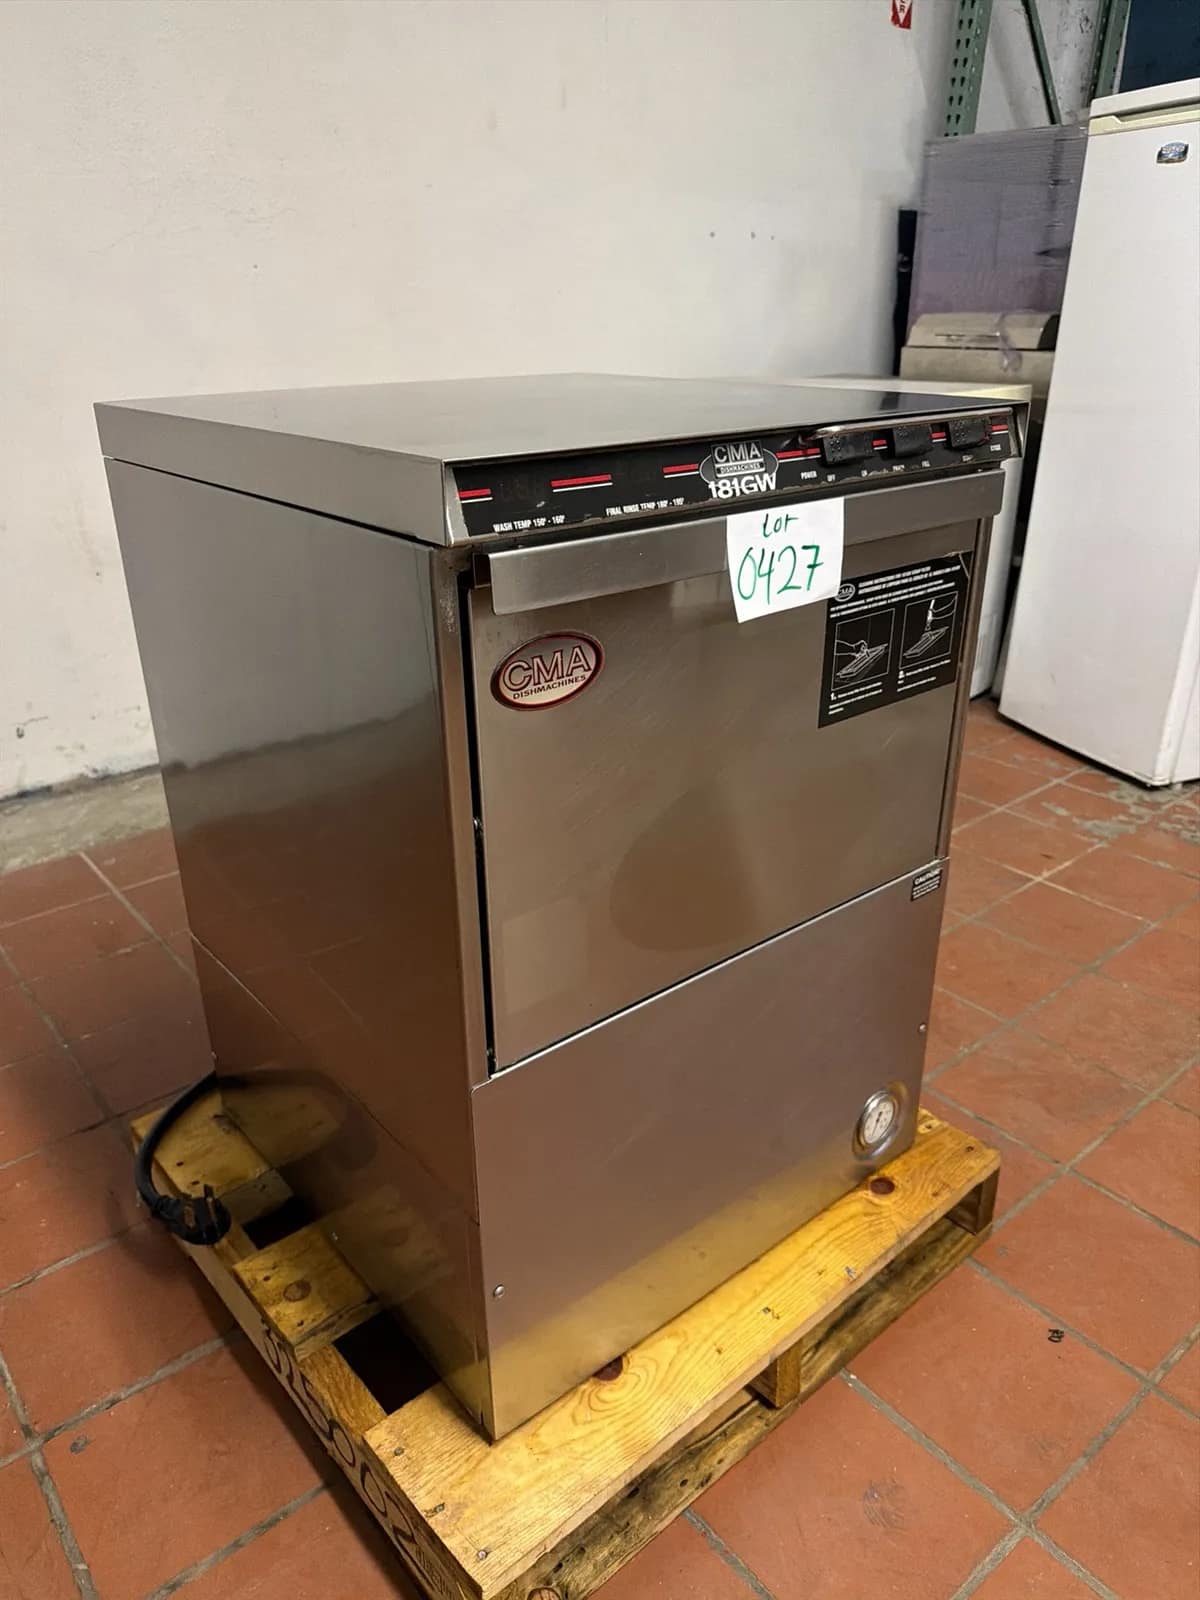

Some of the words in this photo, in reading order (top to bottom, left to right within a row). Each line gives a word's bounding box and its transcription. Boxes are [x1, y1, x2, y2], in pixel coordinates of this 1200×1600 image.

[714, 442, 761, 463] CMA
[720, 462, 761, 474] DISHMACHINES
[800, 470, 817, 480] POWER
[708, 472, 777, 499] 181GW
[606, 506, 622, 517] FINAL
[623, 503, 640, 513] RINSE
[640, 501, 656, 510] TEMP
[493, 521, 513, 532] WASH
[513, 519, 531, 530] TEMP
[738, 545, 824, 605] 0427
[503, 645, 592, 692] CMA
[513, 675, 586, 699] DISHMACHINES
